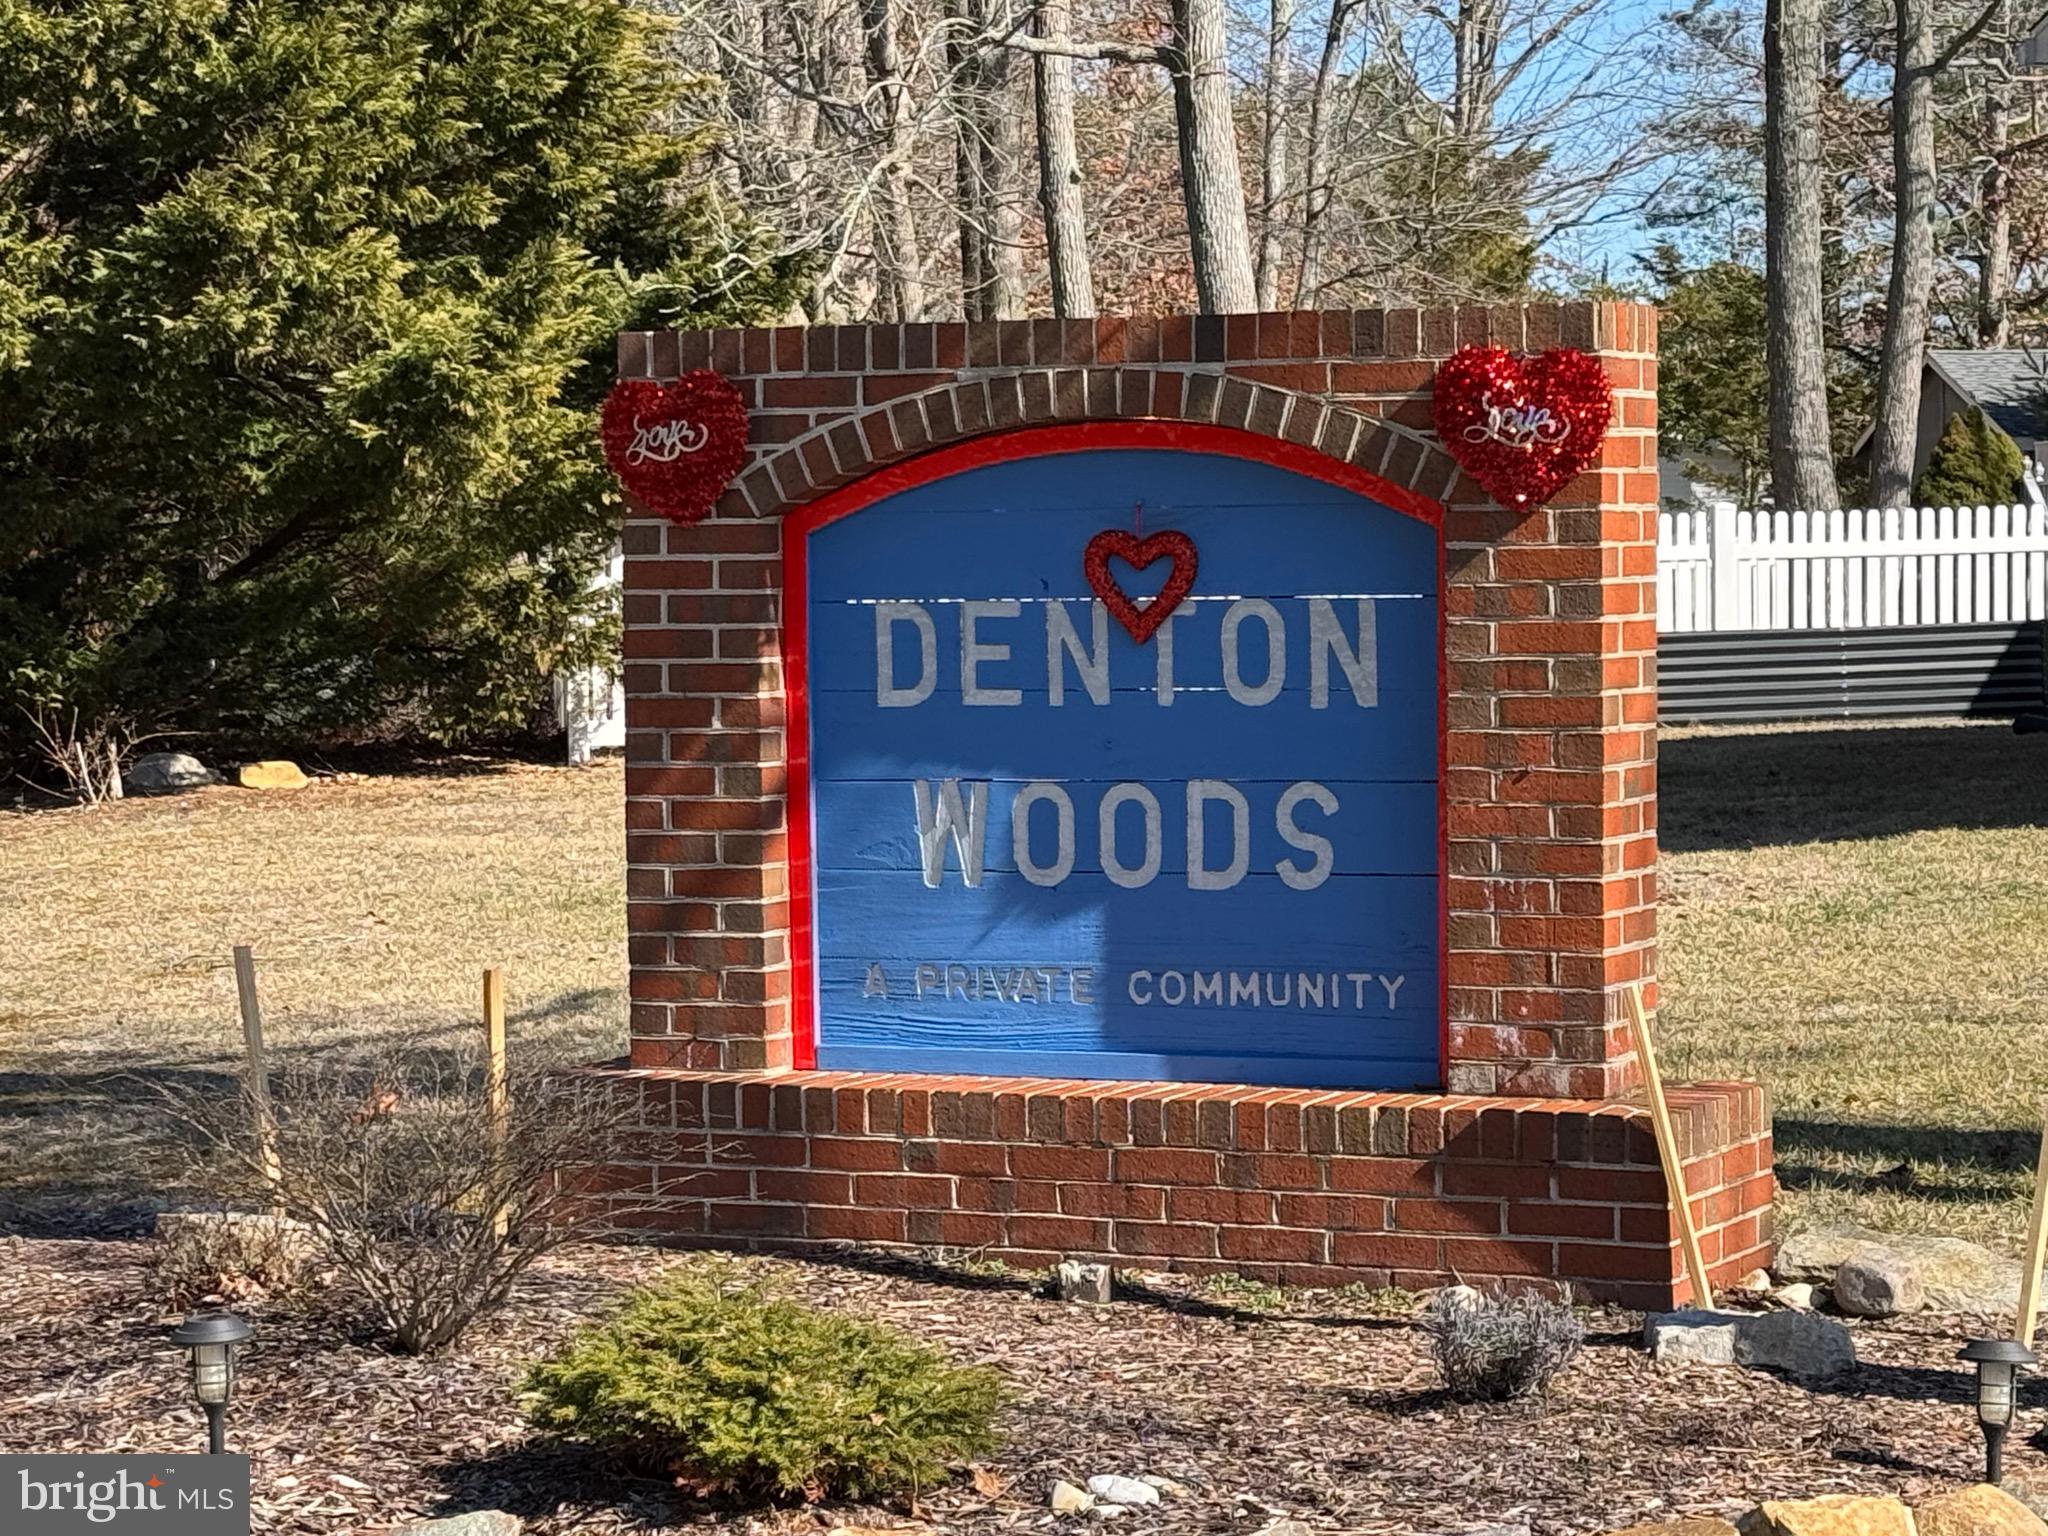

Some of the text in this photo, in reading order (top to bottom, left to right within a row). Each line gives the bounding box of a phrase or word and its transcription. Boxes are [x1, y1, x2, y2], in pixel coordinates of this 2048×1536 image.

[875, 597, 1379, 709] DENTON
[913, 778, 1340, 890] WOODS
[863, 963, 1405, 1010] A PRIVATE COMMUNITY
